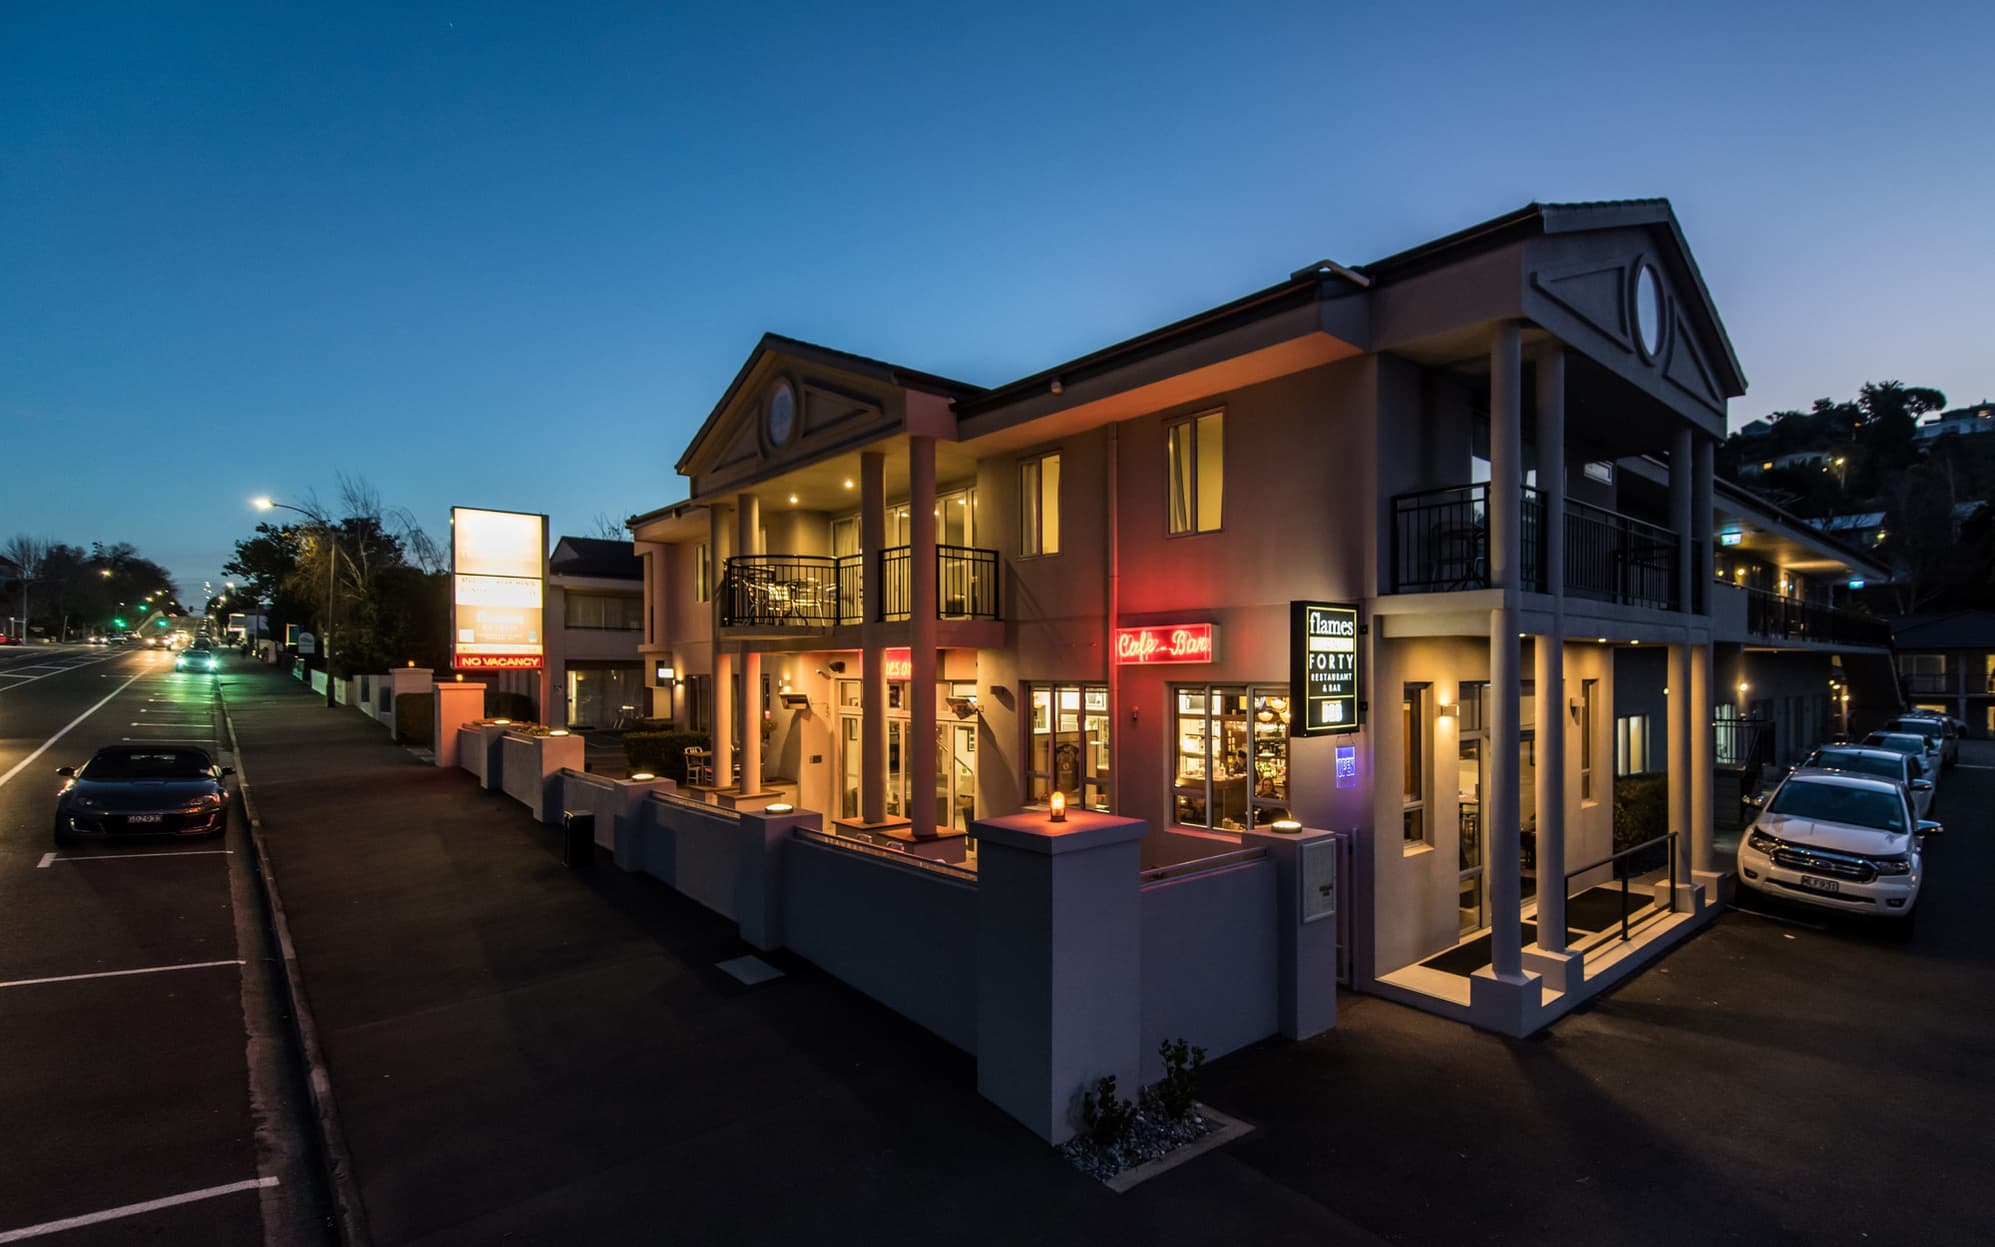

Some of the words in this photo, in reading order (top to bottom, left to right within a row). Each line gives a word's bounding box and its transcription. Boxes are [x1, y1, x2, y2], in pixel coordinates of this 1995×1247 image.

[1309, 612, 1353, 636] flames
[462, 658, 482, 666] NO
[483, 658, 539, 666] VACANCY
[1309, 653, 1354, 670] FORTY
[1311, 672, 1353, 682] RESTAURANT
[1322, 683, 1328, 693] &
[1328, 683, 1341, 693] BAR
